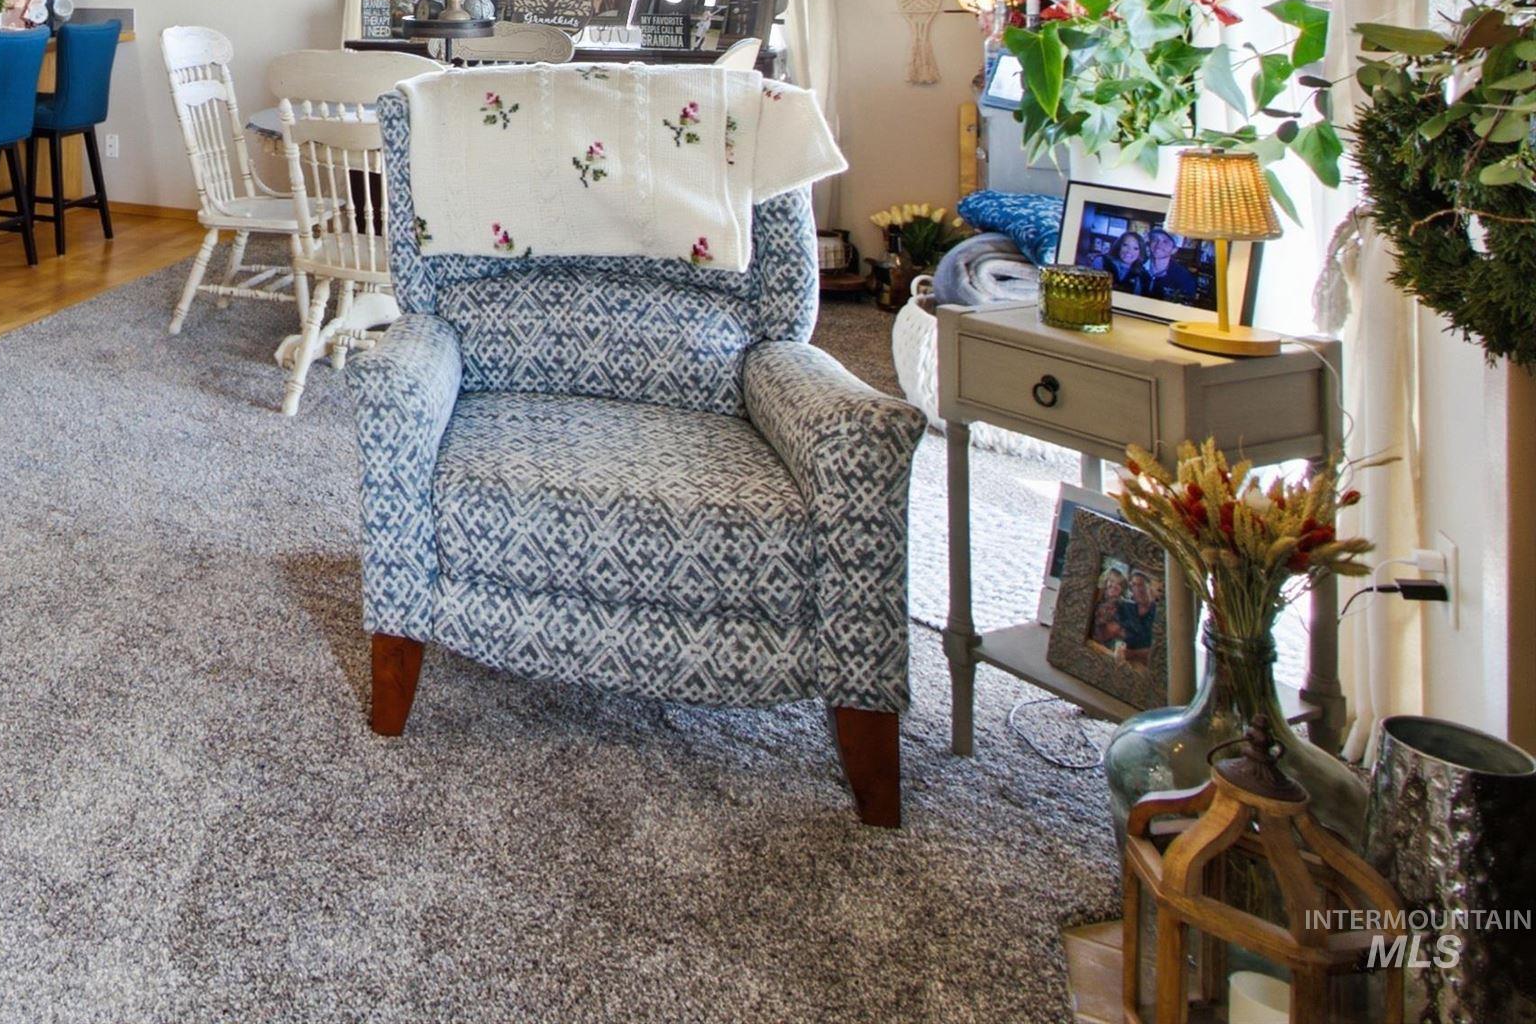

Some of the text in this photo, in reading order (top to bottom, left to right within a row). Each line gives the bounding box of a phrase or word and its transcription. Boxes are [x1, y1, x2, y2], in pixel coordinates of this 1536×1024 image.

[524, 12, 579, 27] Grandkids
[640, 16, 684, 26] MY FAVORITE
[368, 26, 392, 38] NEED
[640, 25, 684, 35] PEOPLE CALL ME
[641, 33, 684, 47] GRANDMA
